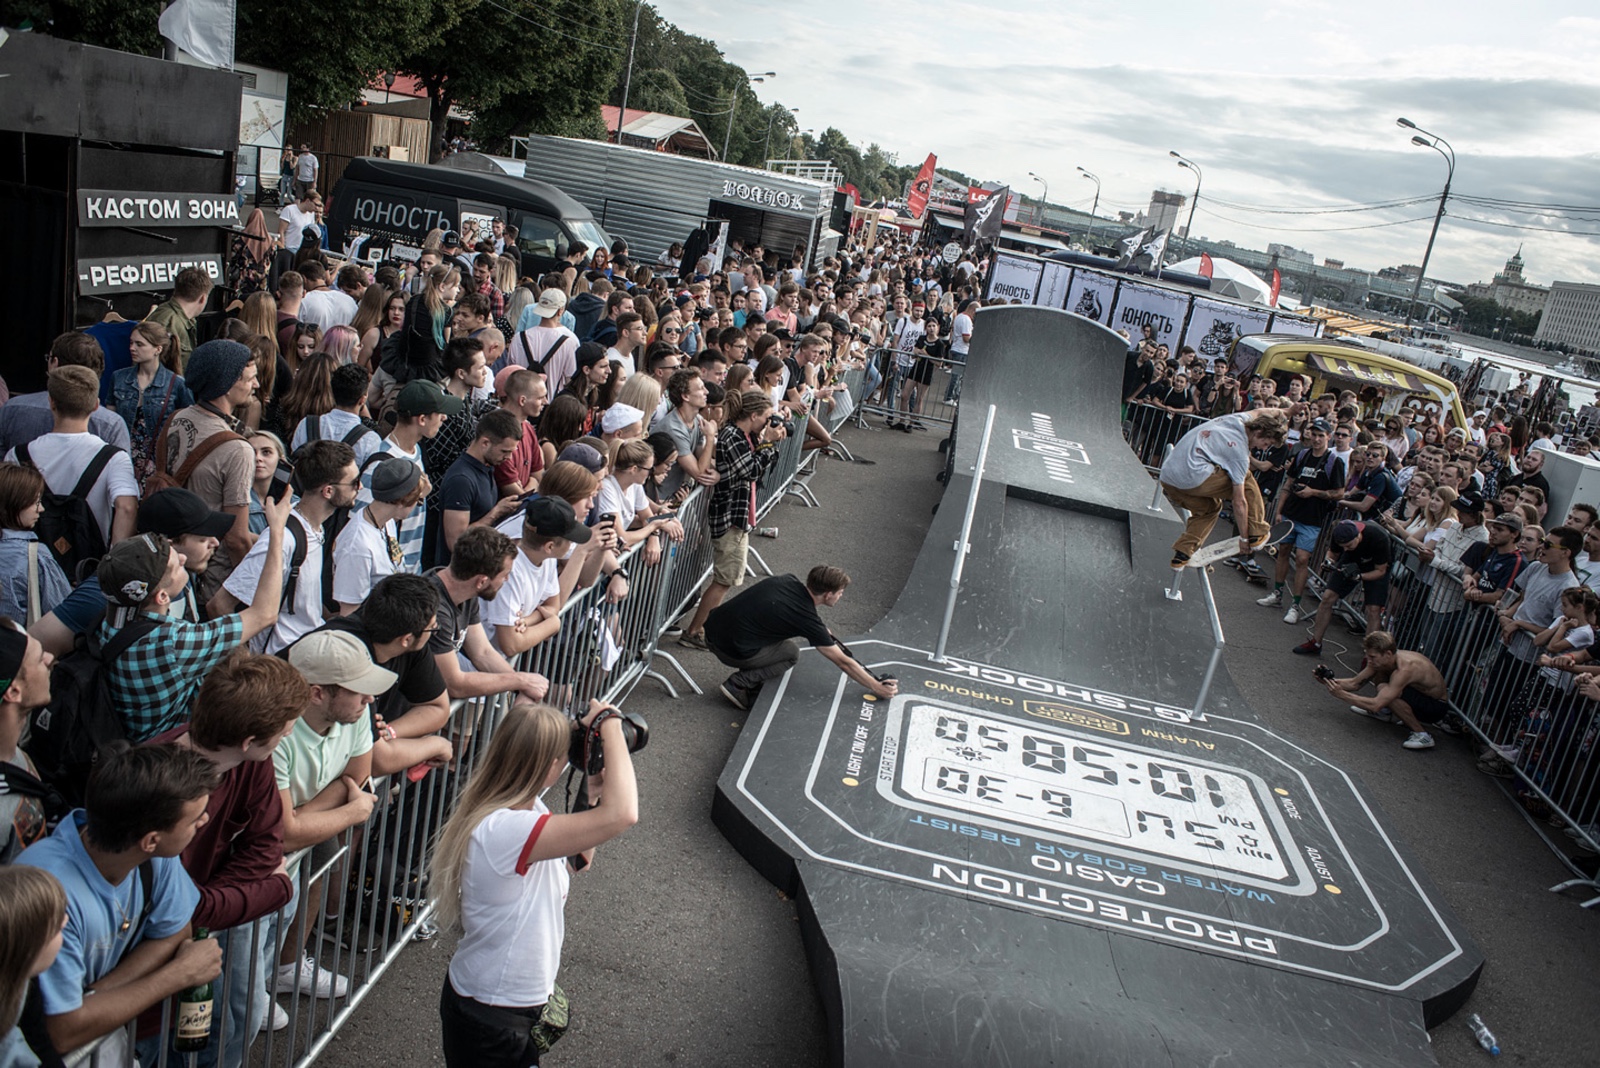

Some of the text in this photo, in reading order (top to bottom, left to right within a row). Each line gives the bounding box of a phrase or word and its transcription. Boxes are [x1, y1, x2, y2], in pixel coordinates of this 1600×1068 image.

[86, 197, 240, 219] КАСТОМ ЗОНА
[353, 197, 451, 232] ЮНОСТЬ
[993, 282, 1031, 300] ЮНОСТЬ
[1121, 306, 1173, 334] ЮНОСТЬ
[924, 680, 1014, 706] CHRONO
[945, 657, 1191, 724] G-SHOCK
[859, 701, 875, 722] LIGHT
[846, 724, 870, 777] LIGHT ON/OFF
[935, 716, 1009, 752] 50
[1141, 728, 1215, 750] ALARM
[879, 735, 898, 782] START STOP
[1021, 735, 1226, 808] 10:58
[1217, 814, 1256, 831] PM
[1280, 797, 1302, 820] MODE
[909, 815, 1276, 905] WATER 20BAR RESIST
[1031, 854, 1167, 896] CASIO
[1304, 845, 1334, 883] ADJUST
[932, 863, 1278, 955] PROTECTION
